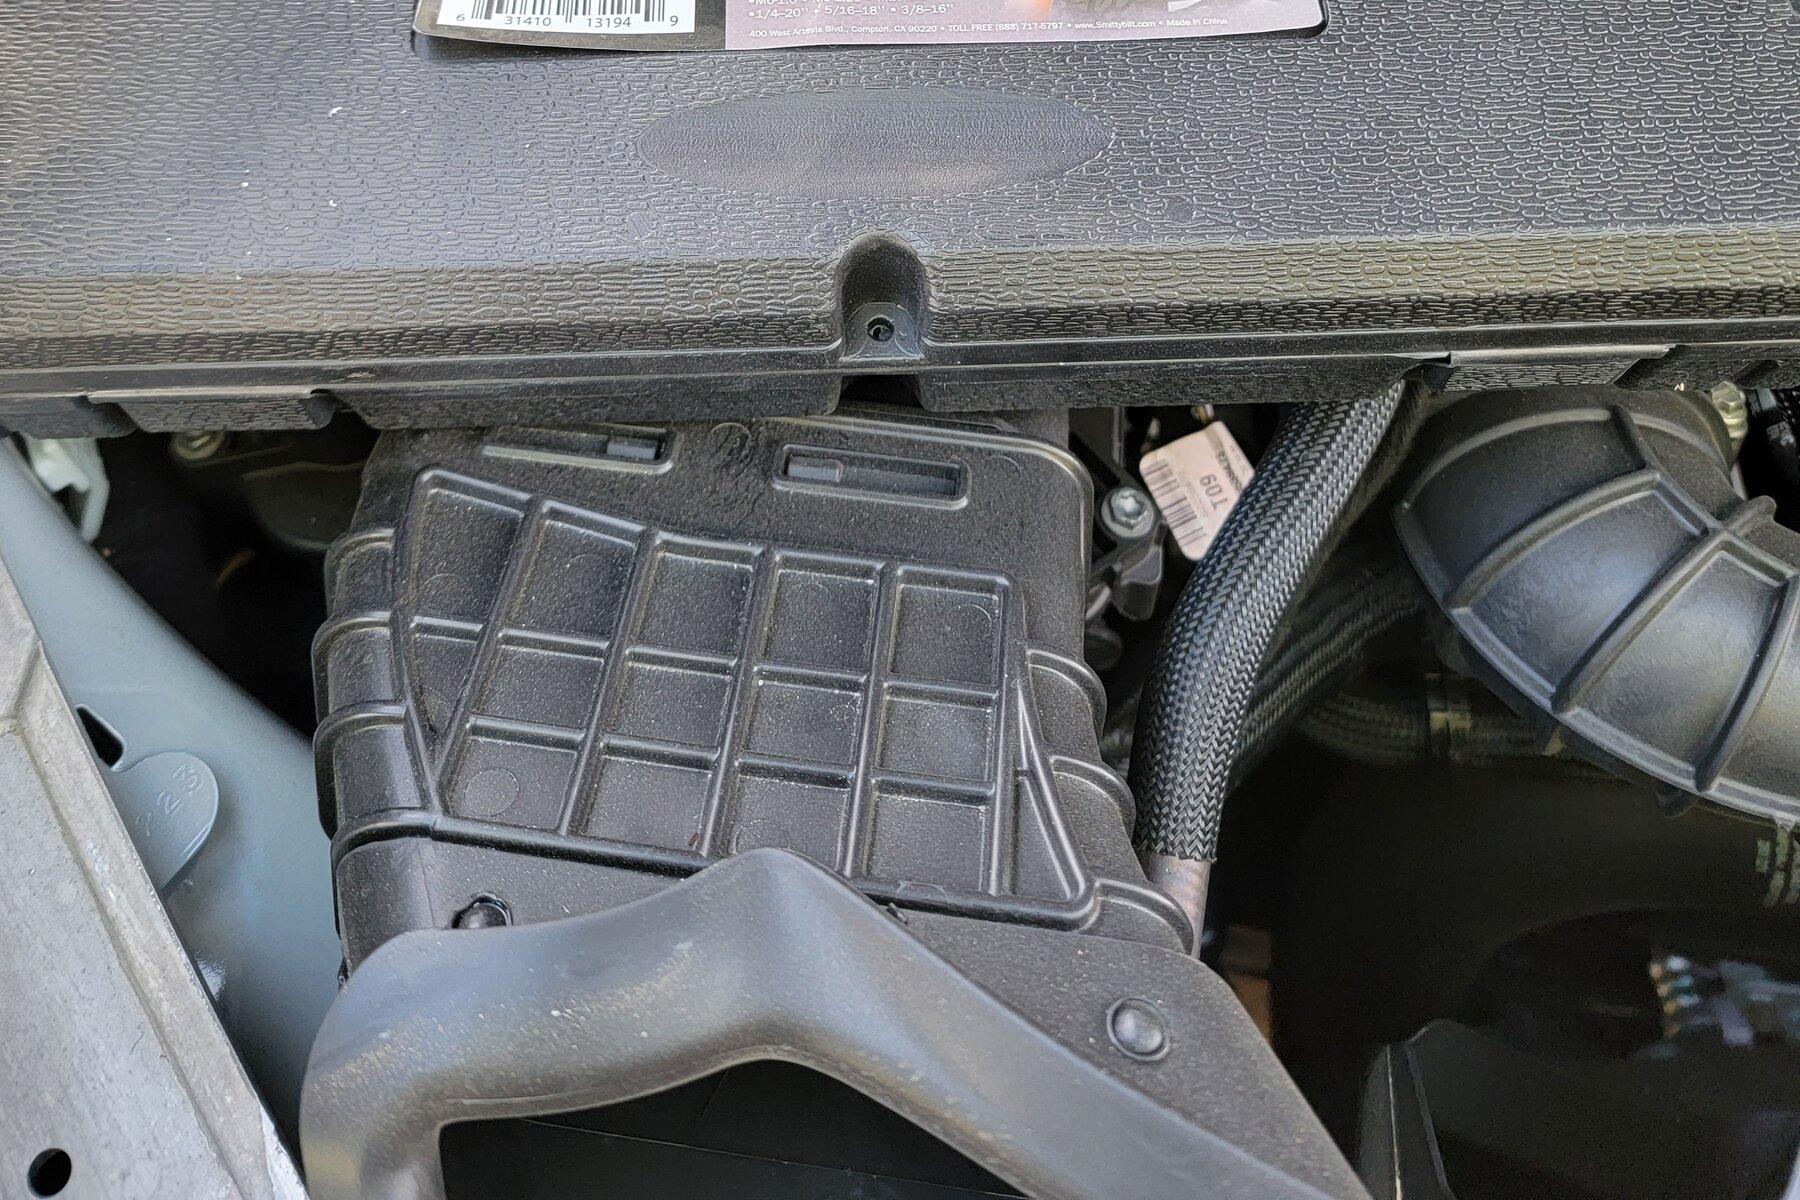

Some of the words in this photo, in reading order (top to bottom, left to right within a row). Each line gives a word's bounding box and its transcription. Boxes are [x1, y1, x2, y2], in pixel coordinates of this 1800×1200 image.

[455, 13, 466, 22] 6
[504, 15, 552, 27] 31410
[587, 17, 632, 28] 13194
[670, 15, 679, 27] 9
[749, 30, 768, 38] 400
[769, 28, 791, 38] West
[851, 25, 892, 34] Compton,
[894, 25, 907, 33] CA
[908, 25, 938, 33] 90220
[947, 24, 971, 32] TOLL
[971, 23, 994, 31] FREE
[1021, 22, 1063, 31] 717-5797
[1074, 20, 1156, 30] www.Smittybilt.com
[1167, 19, 1191, 27] Made
[1203, 17, 1228, 26] China
[1200, 473, 1228, 511] T09
